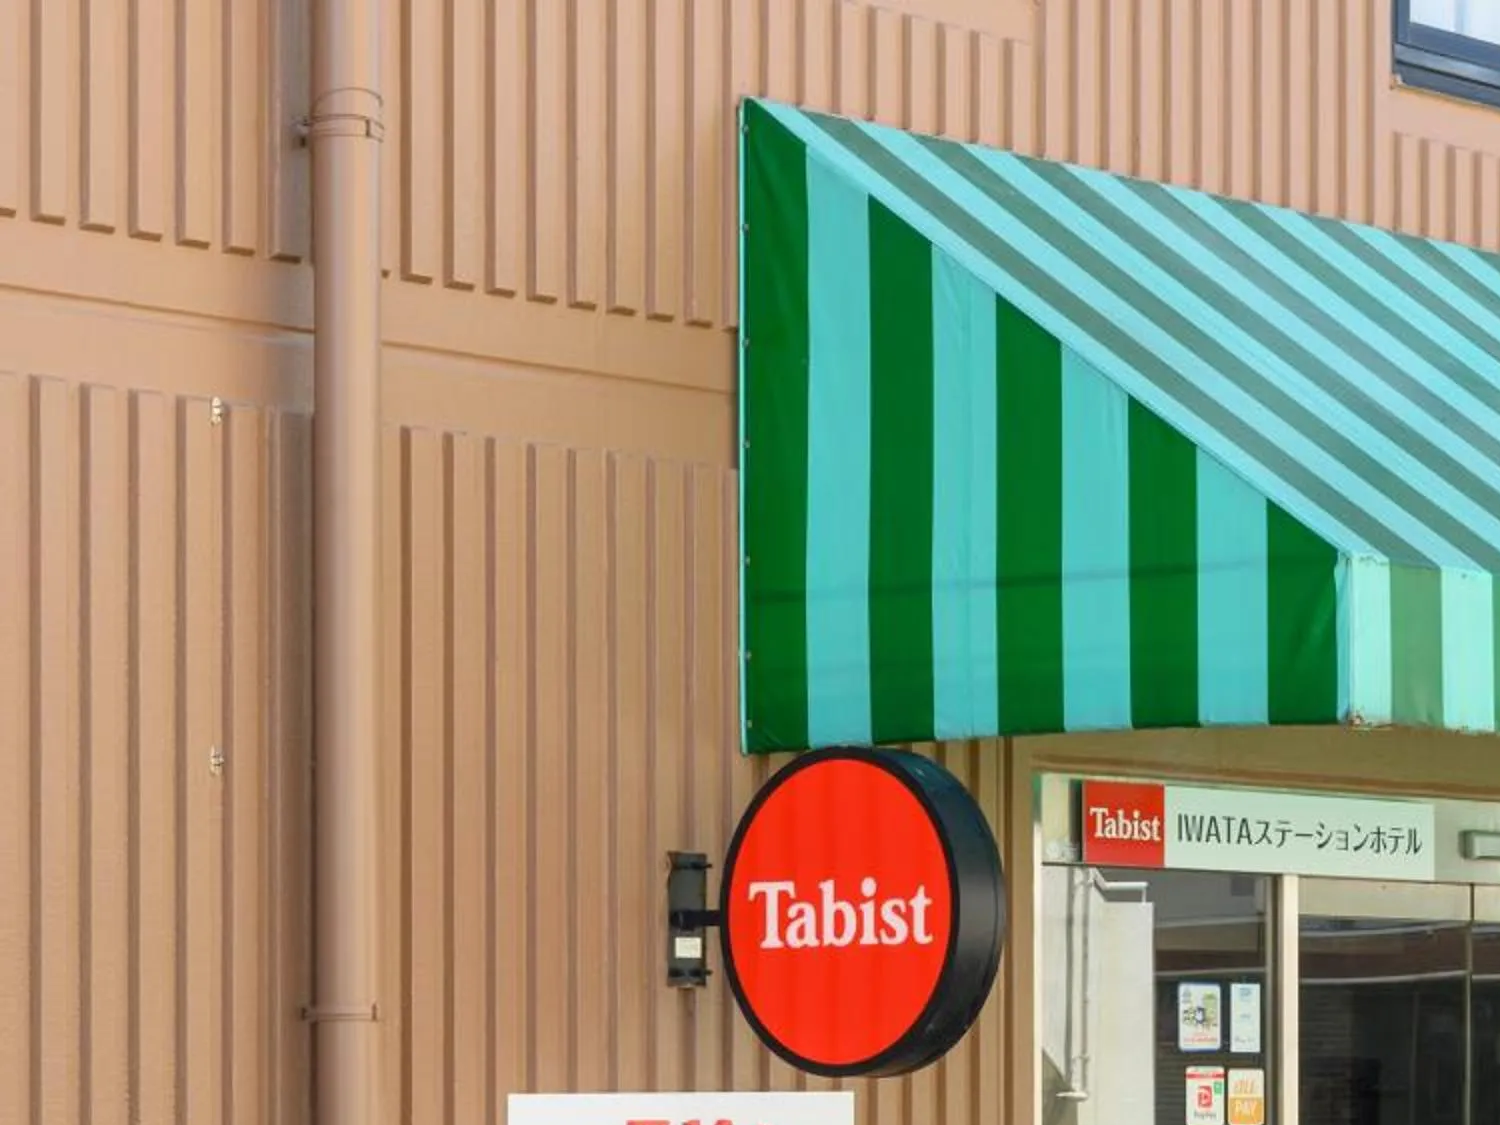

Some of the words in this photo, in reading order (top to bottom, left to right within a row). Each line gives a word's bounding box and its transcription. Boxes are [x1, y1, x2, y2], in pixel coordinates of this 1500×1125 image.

[1089, 806, 1163, 843] Tabist
[1177, 812, 1423, 856] IWATAステーションホテル
[748, 876, 934, 949] Tabist
